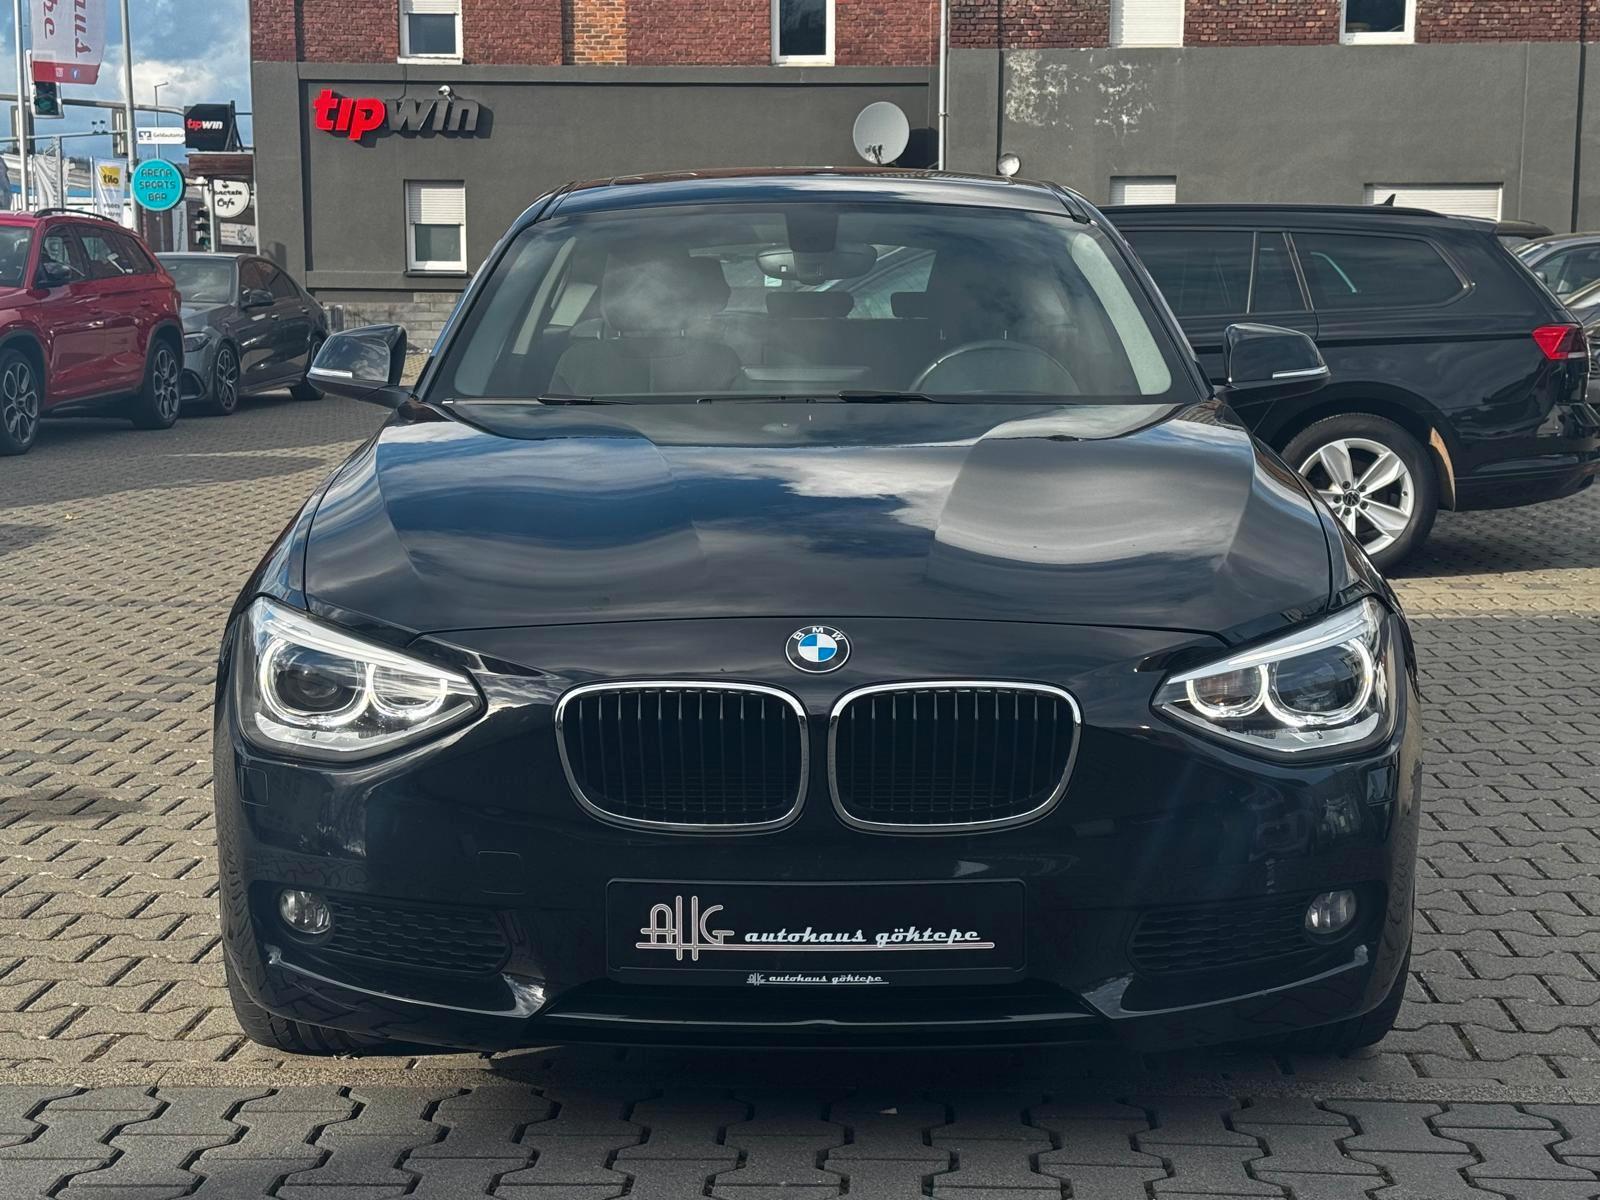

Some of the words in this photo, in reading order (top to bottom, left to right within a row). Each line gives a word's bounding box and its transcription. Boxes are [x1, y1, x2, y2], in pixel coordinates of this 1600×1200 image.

[312, 88, 480, 141] tipwin
[187, 118, 224, 131] tipwin
[141, 168, 173, 178] ARENA
[139, 180, 176, 190] SPORTS
[147, 192, 168, 201] BAR
[792, 626, 845, 641] BMW
[744, 926, 867, 943] autohaus
[875, 926, 982, 948] göktepe
[769, 974, 828, 983] autohaus
[832, 974, 883, 984] göktepe
